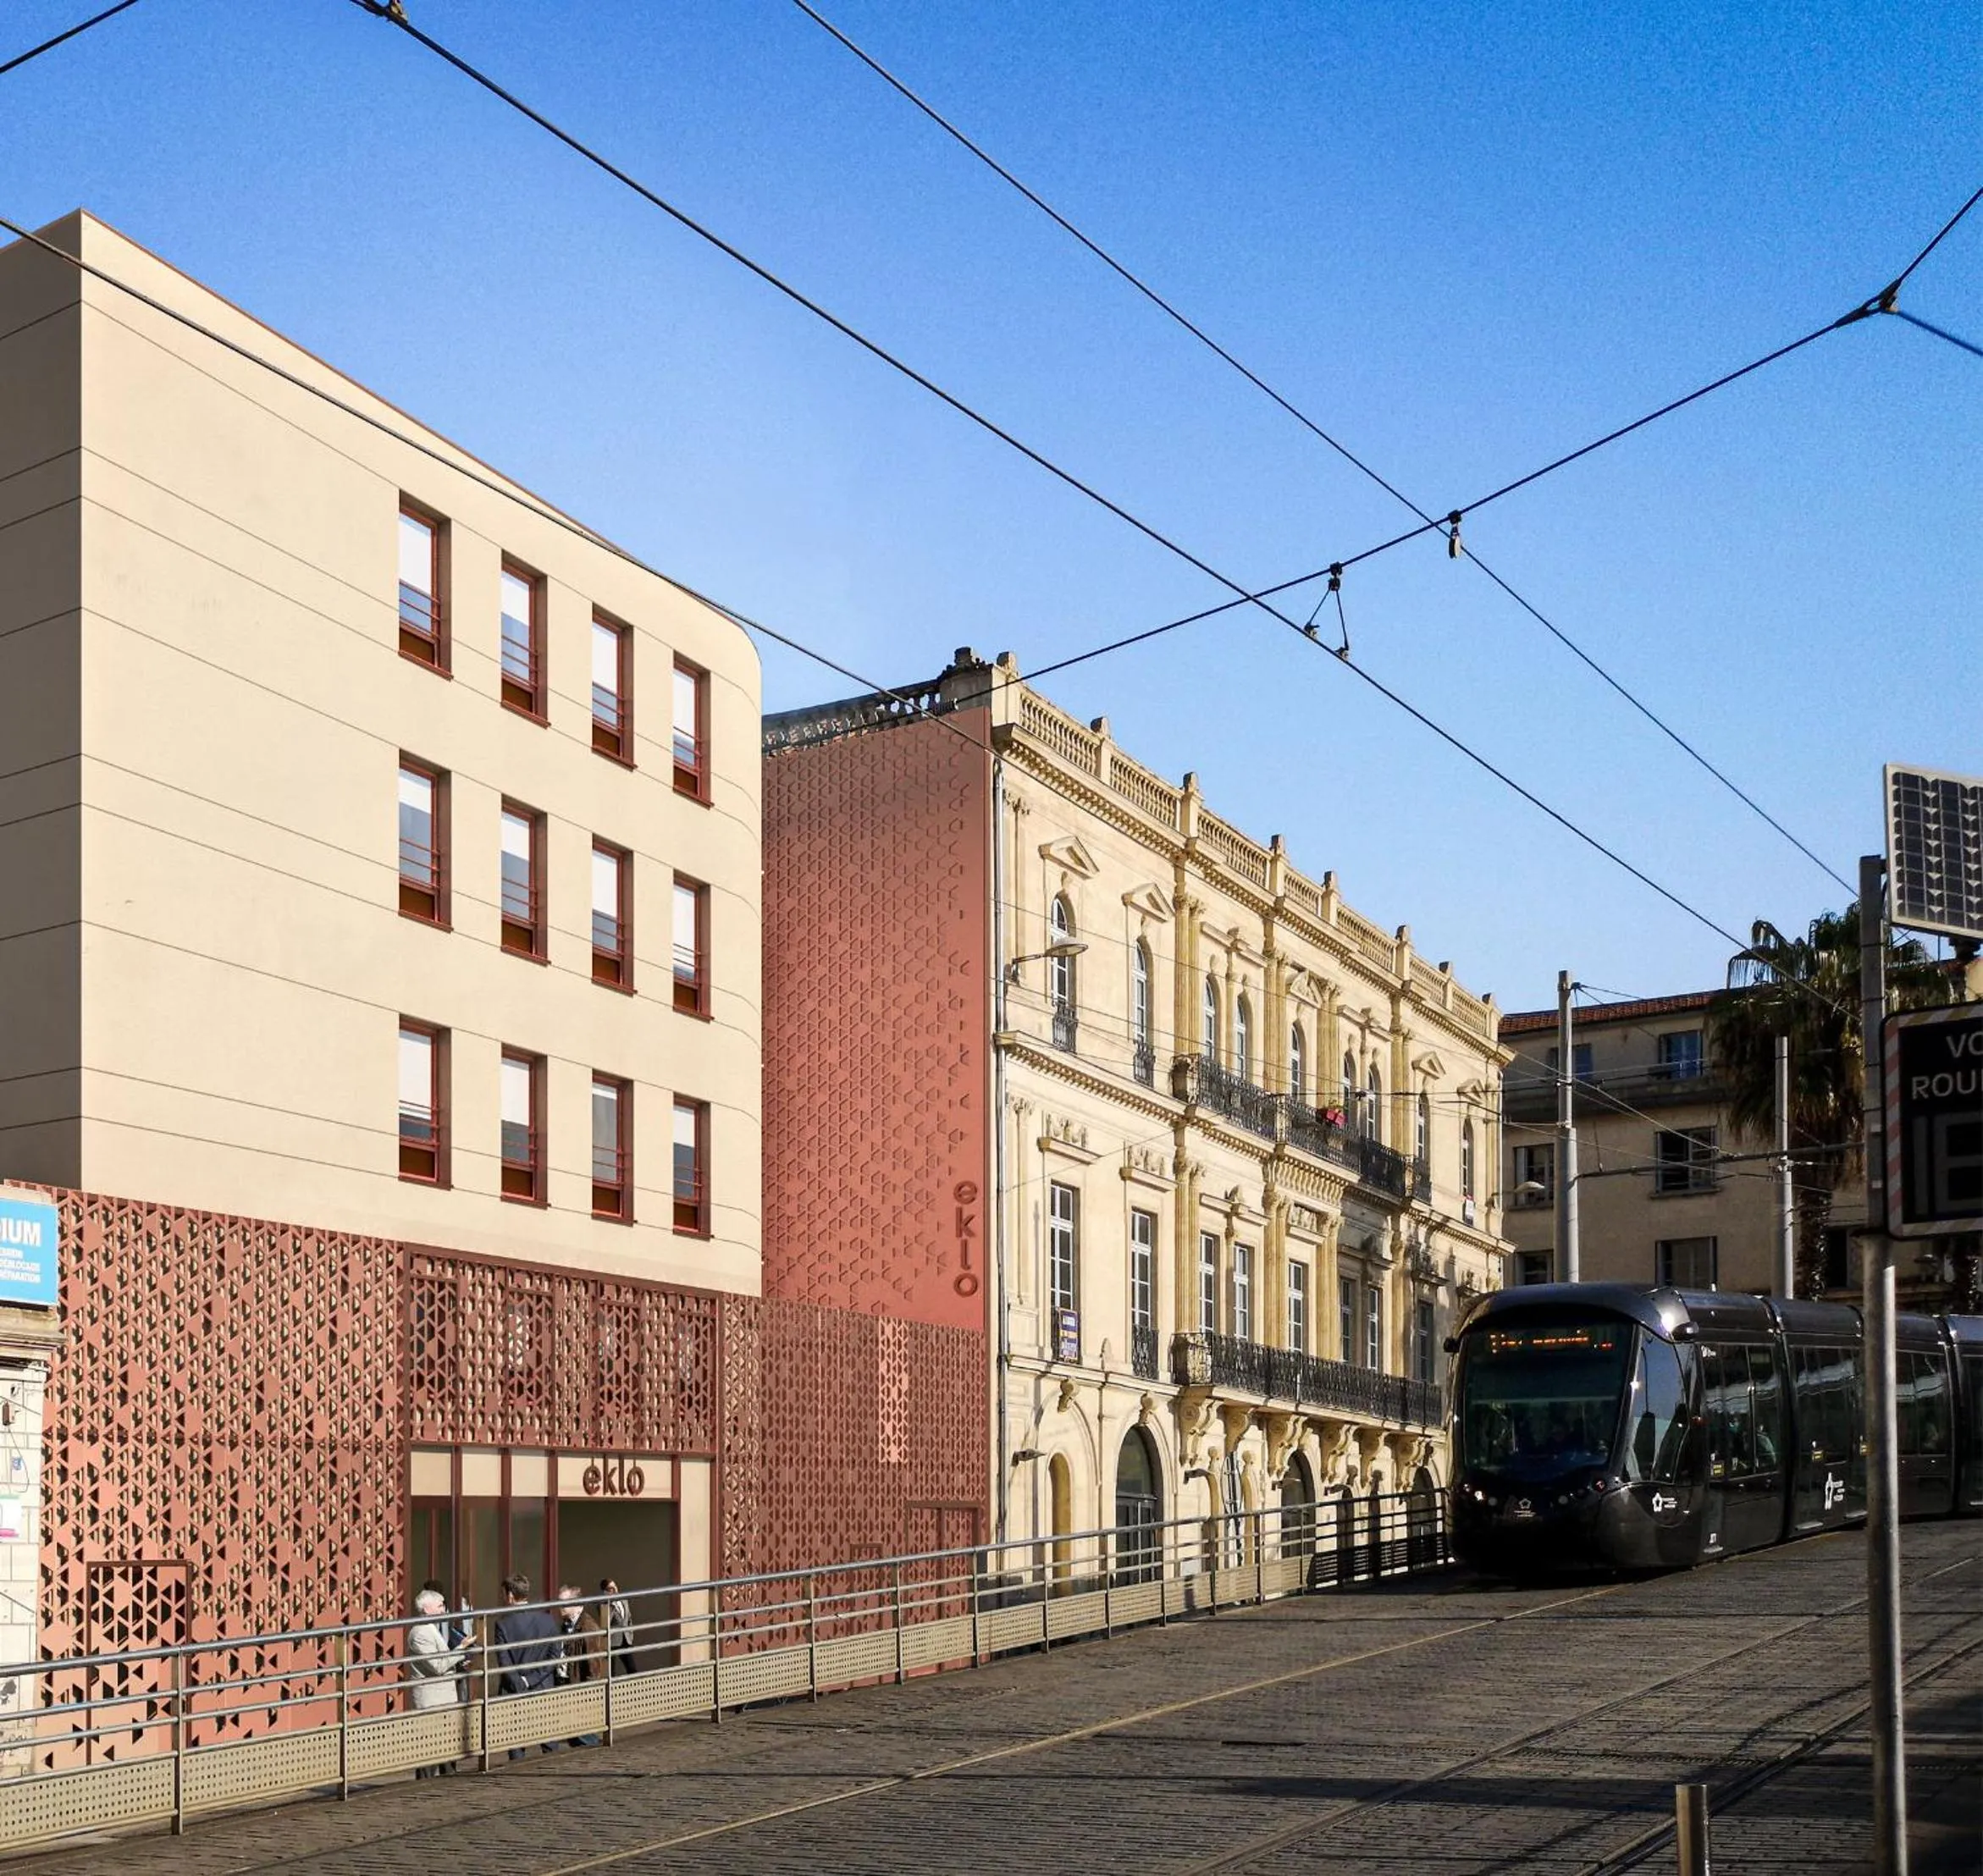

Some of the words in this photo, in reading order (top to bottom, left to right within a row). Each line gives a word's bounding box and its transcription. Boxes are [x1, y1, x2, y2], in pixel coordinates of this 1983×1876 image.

[1912, 1069, 1983, 1100] ROU
[0, 1217, 41, 1248] IUM
[953, 1181, 978, 1298] eklo
[583, 1454, 645, 1496] eklo
